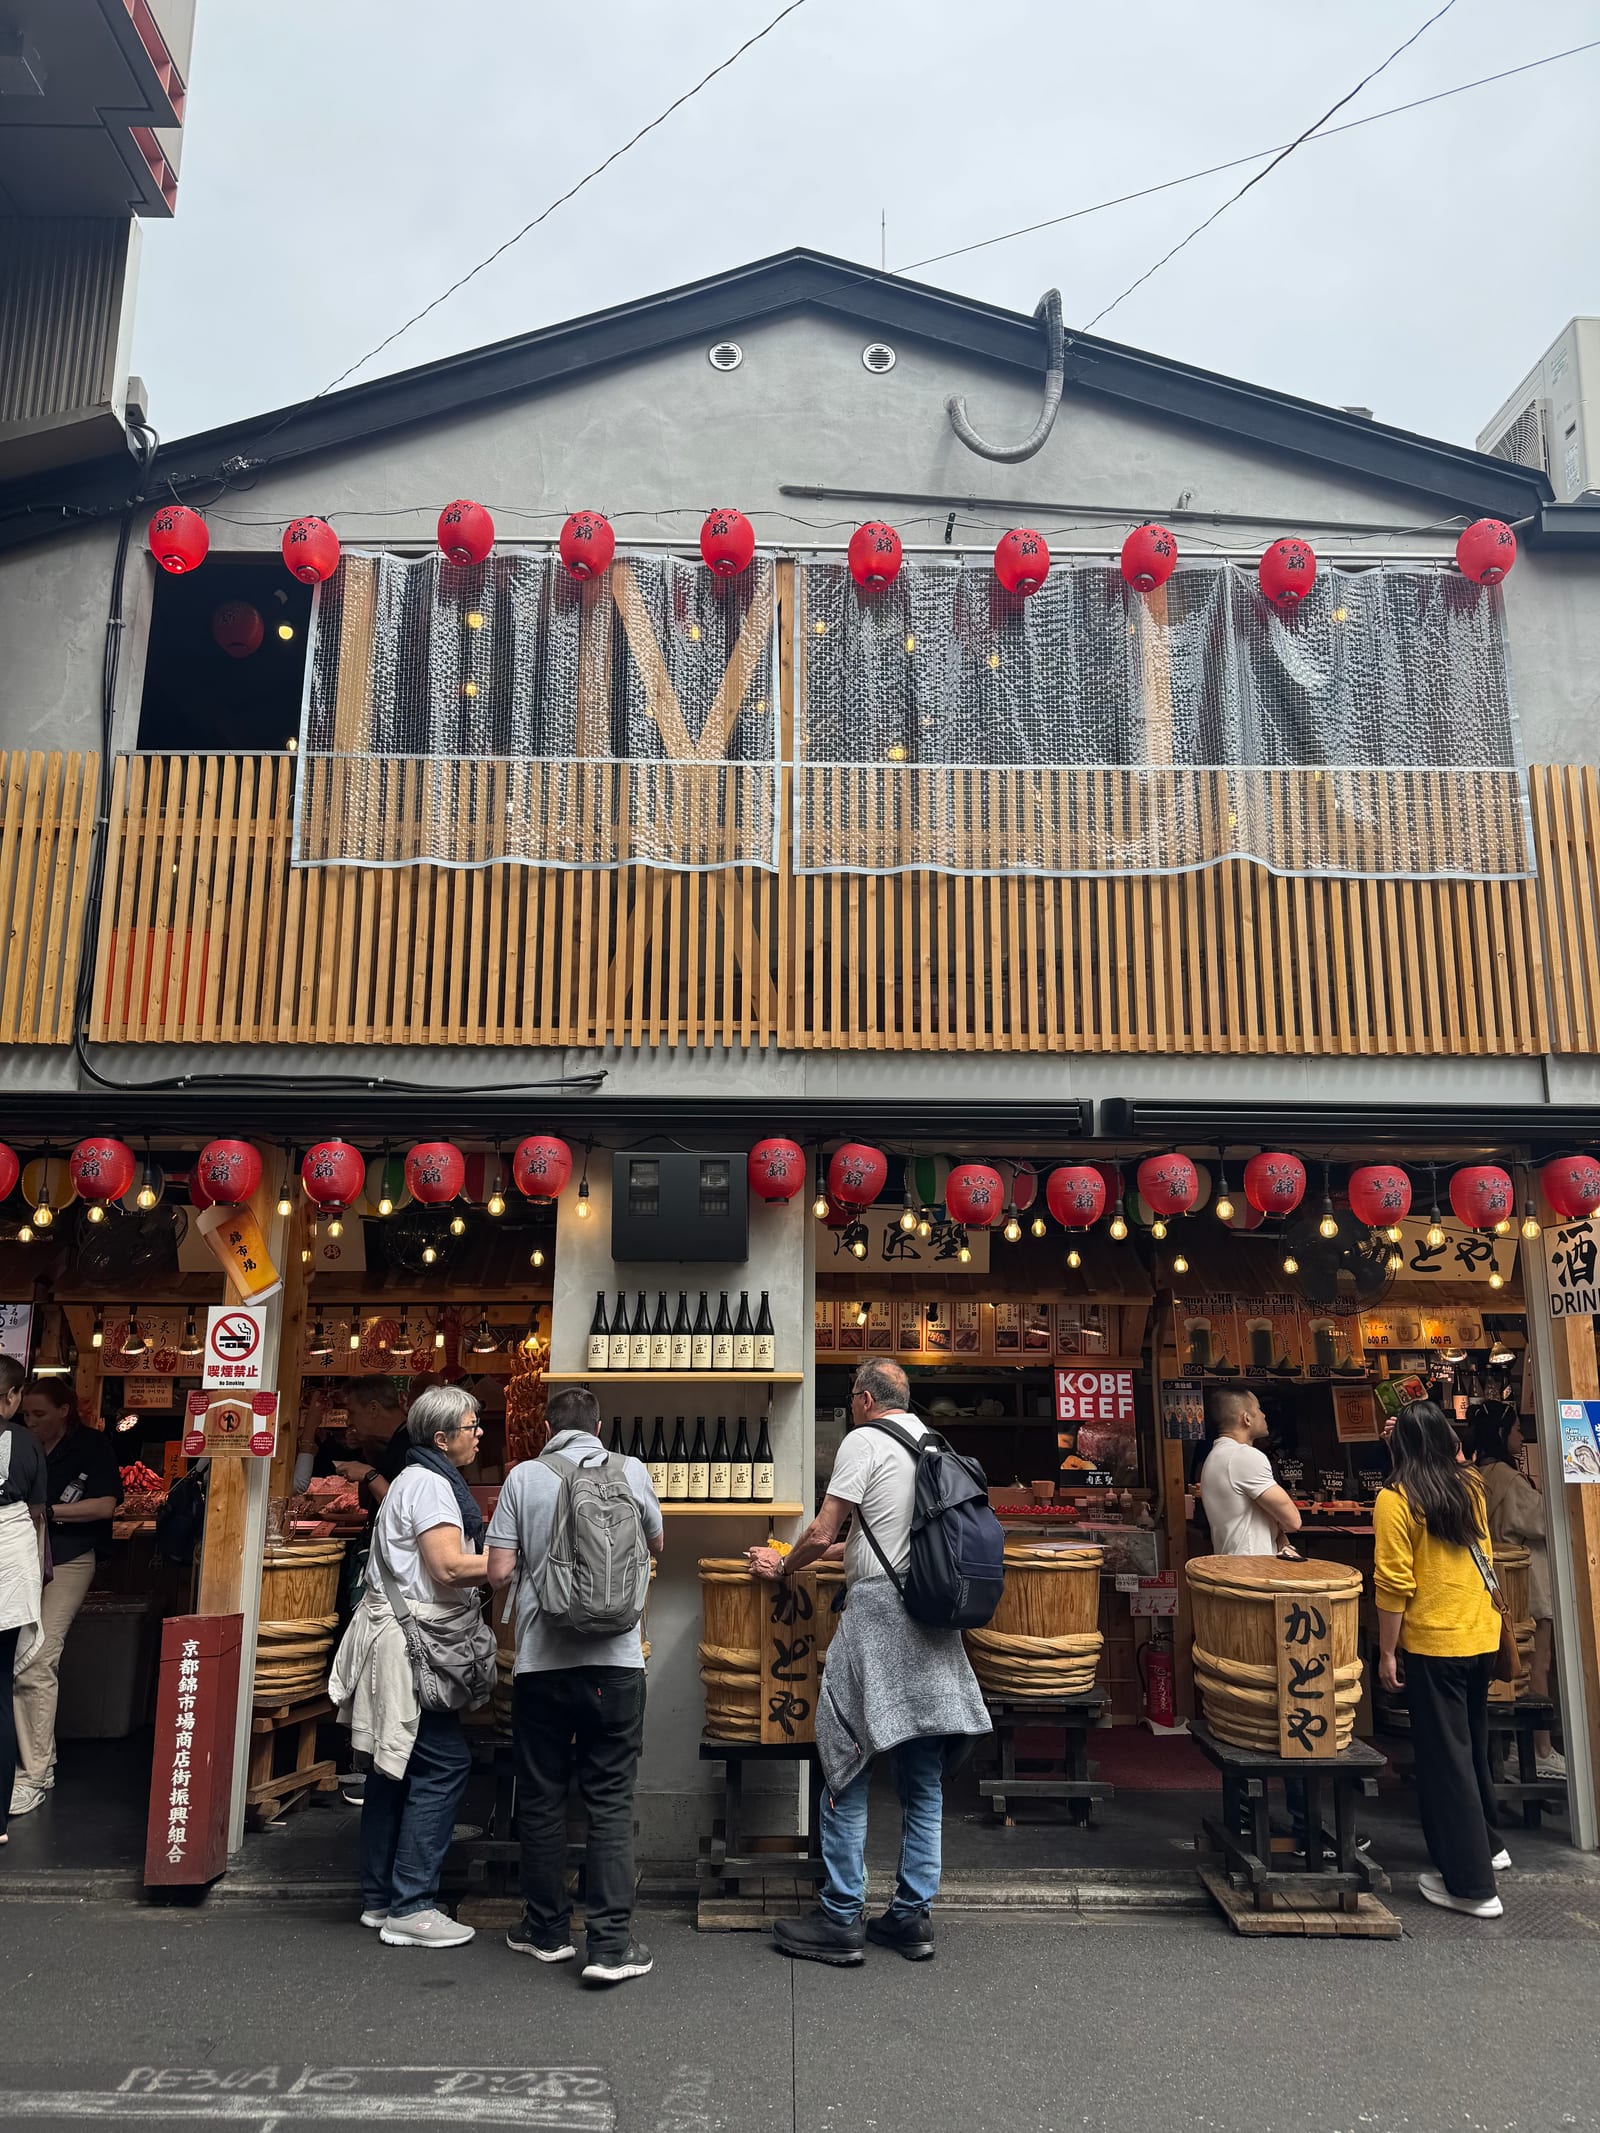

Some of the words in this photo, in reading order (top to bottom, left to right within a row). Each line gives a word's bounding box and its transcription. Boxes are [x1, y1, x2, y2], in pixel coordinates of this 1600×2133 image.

[156, 516, 172, 533] 錦
[445, 511, 461, 527] 錦
[291, 528, 307, 545] 錦
[574, 526, 593, 543] 錦
[711, 521, 728, 539] 錦
[876, 537, 892, 554] 錦
[1020, 541, 1038, 557] 錦
[1153, 540, 1171, 558] 錦
[1288, 555, 1305, 571] 錦
[80, 1158, 101, 1179] 錦
[210, 1164, 231, 1183] 錦
[313, 1161, 334, 1180] 錦
[420, 1165, 441, 1186] 錦
[528, 1157, 547, 1176] 錦
[767, 1159, 787, 1179] 錦
[843, 1170, 864, 1188] 錦
[1169, 1179, 1189, 1198] 錦
[1273, 1177, 1294, 1196] 錦
[970, 1187, 990, 1207] 錦
[1074, 1190, 1094, 1211] 錦
[1381, 1190, 1402, 1210] 錦
[1487, 1190, 1507, 1211] 錦
[228, 1231, 257, 1272] 錦市場
[1552, 1222, 1597, 1287] 酒
[1188, 1304, 1234, 1316] BEER
[1249, 1304, 1295, 1316] BEER
[1551, 1287, 1600, 1315] DRIN
[207, 1365, 259, 1378] 喫煙禁止
[1058, 1372, 1132, 1395] KOBE
[1059, 1396, 1133, 1419] BEEF
[768, 1582, 815, 1736] かどや
[1284, 1602, 1330, 1752] かどや
[165, 1639, 201, 1864] 京都錦市場商店街振興組合
